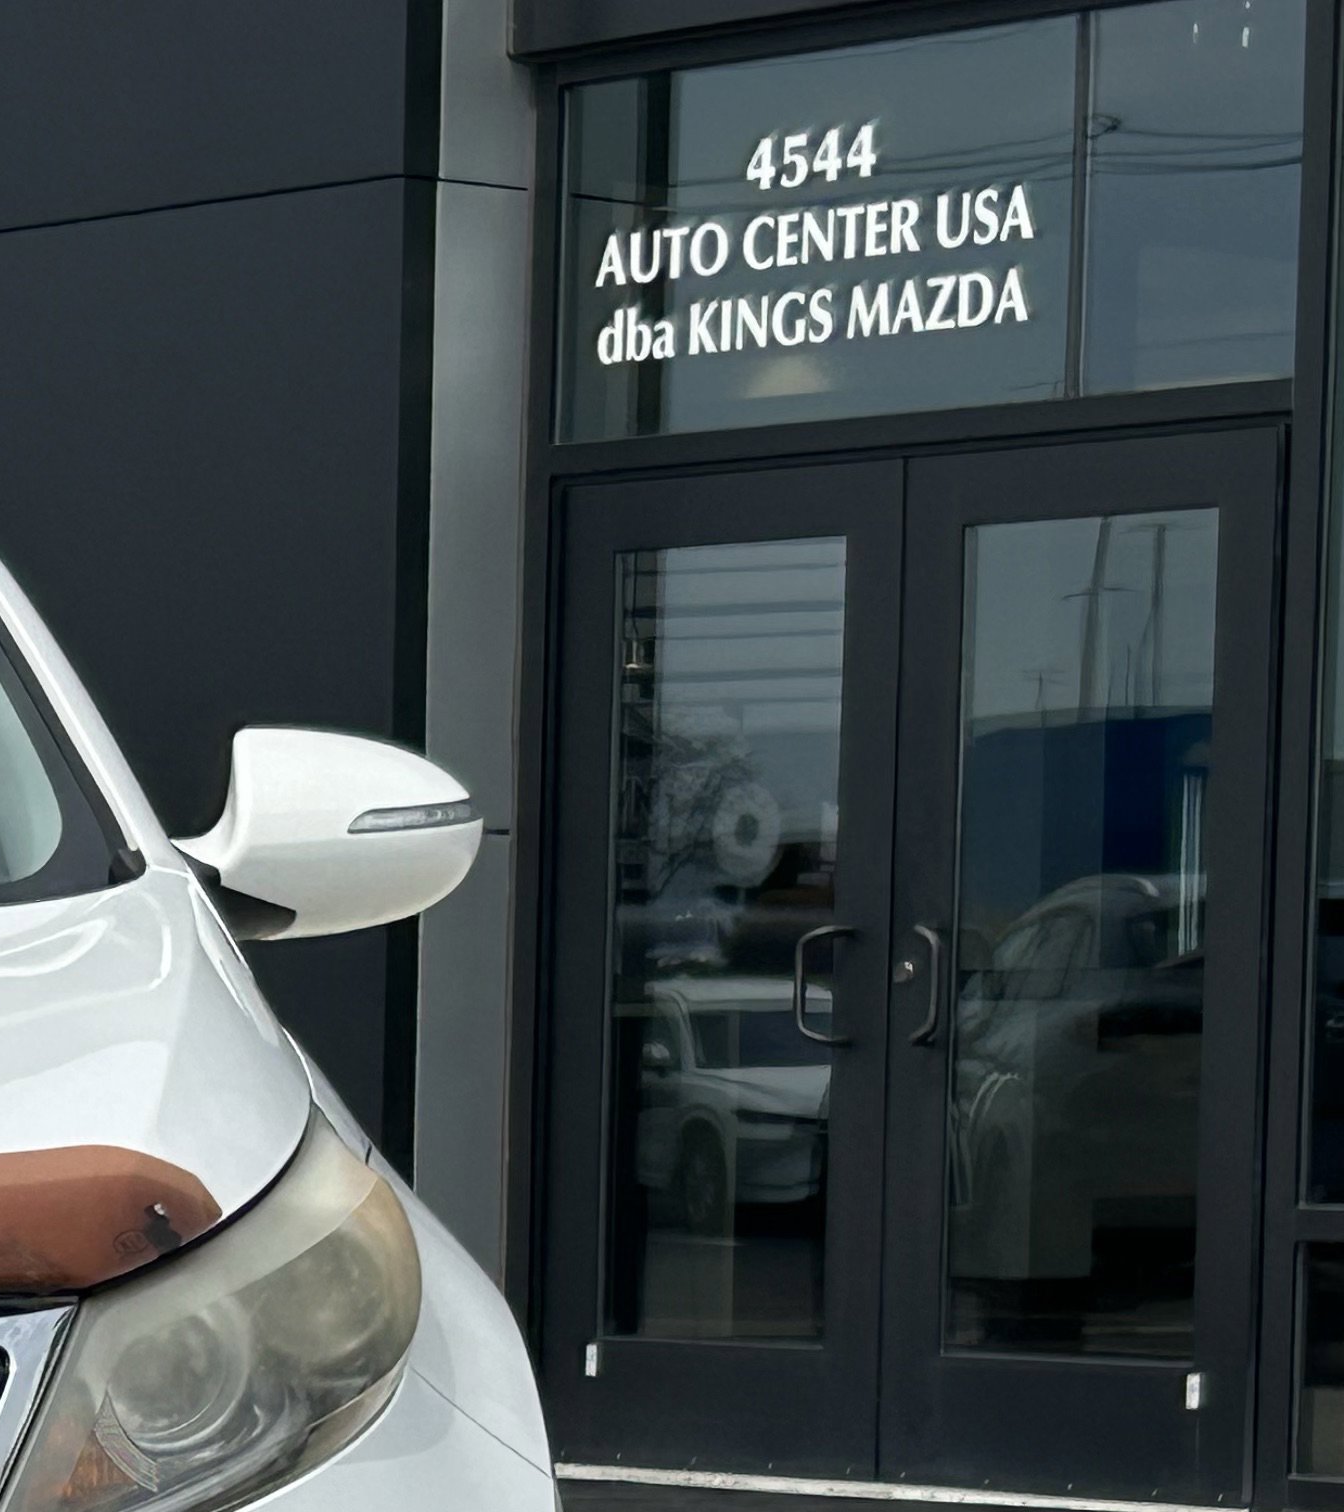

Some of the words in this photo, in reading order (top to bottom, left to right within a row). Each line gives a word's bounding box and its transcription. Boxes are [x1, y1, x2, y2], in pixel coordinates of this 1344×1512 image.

[745, 124, 878, 190] 4544
[595, 221, 730, 288] AUTO
[742, 199, 922, 271] CENTER
[936, 184, 1035, 250] USA
[597, 306, 676, 365] dba
[688, 288, 834, 356] KINGS
[846, 267, 1030, 340] MAZDA
